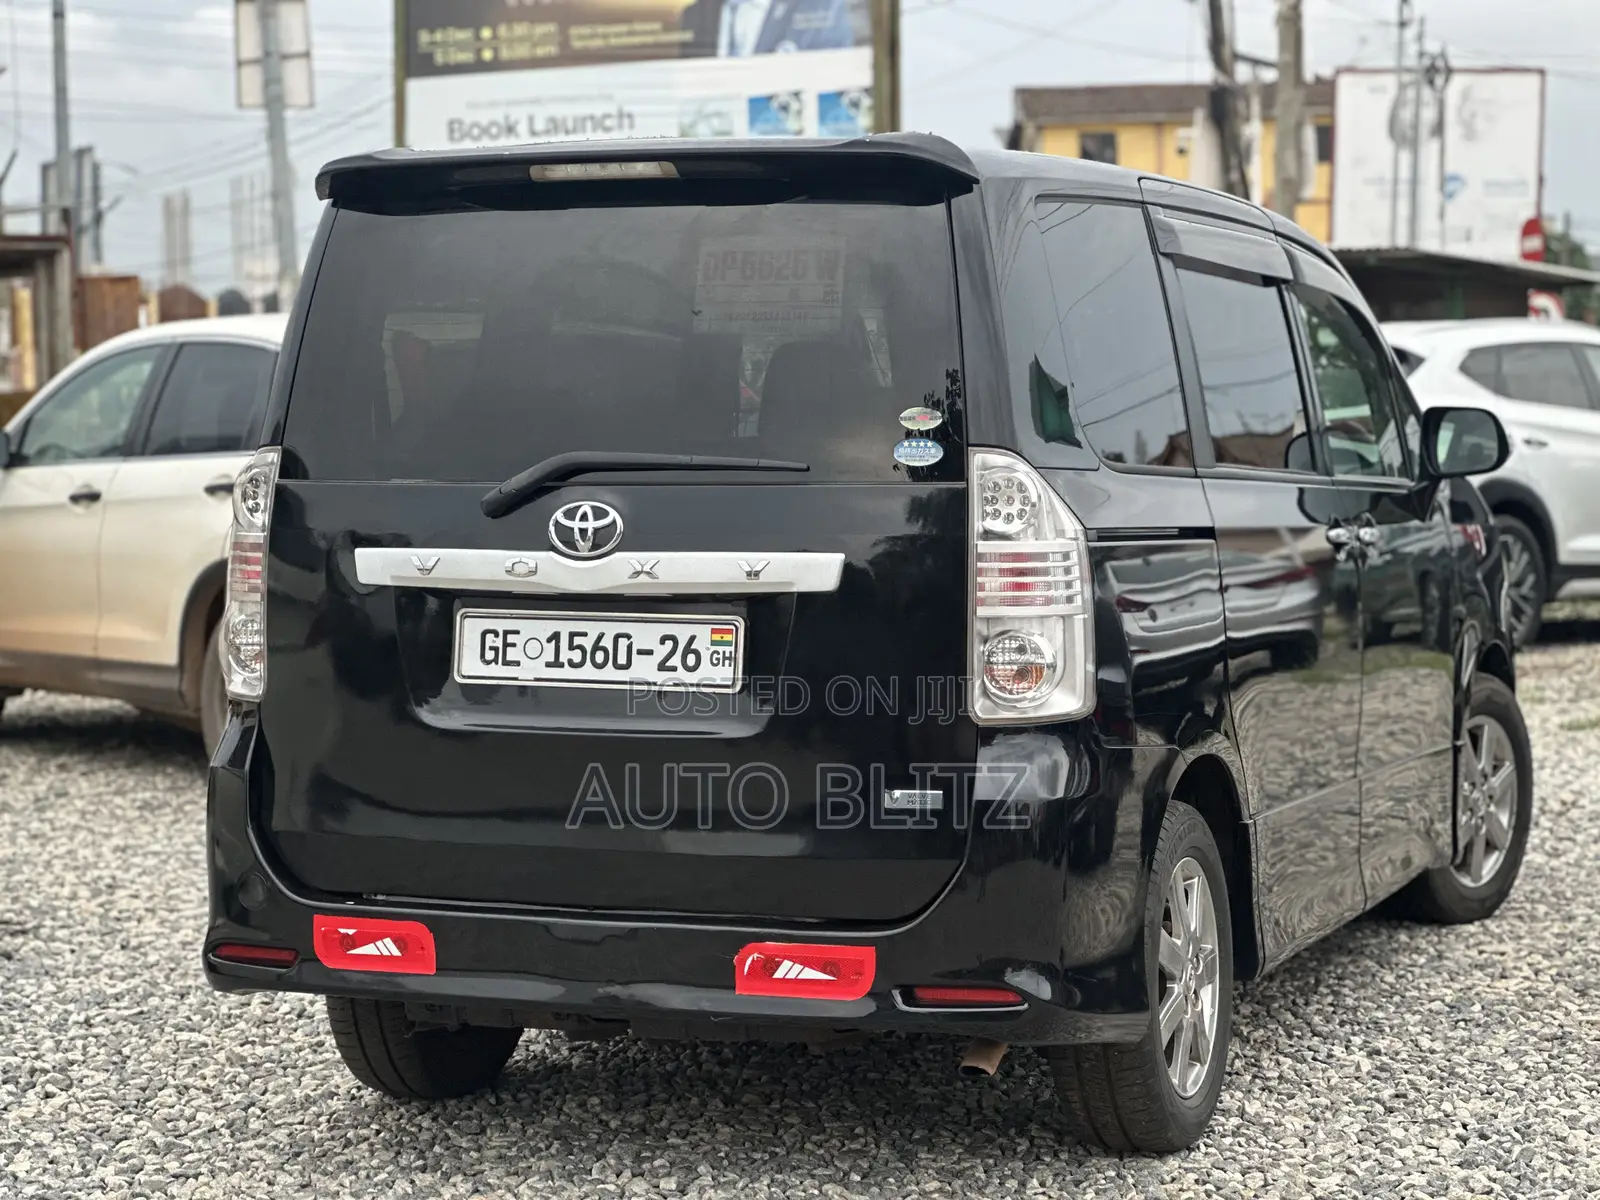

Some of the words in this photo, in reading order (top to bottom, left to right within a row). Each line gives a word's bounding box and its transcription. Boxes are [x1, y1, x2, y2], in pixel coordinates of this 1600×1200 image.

[449, 115, 519, 143] Book
[528, 106, 635, 137] Launch
[410, 556, 771, 581] VOXY
[480, 628, 521, 667] GE
[545, 631, 702, 673] 1560-26
[709, 650, 733, 668] GH
